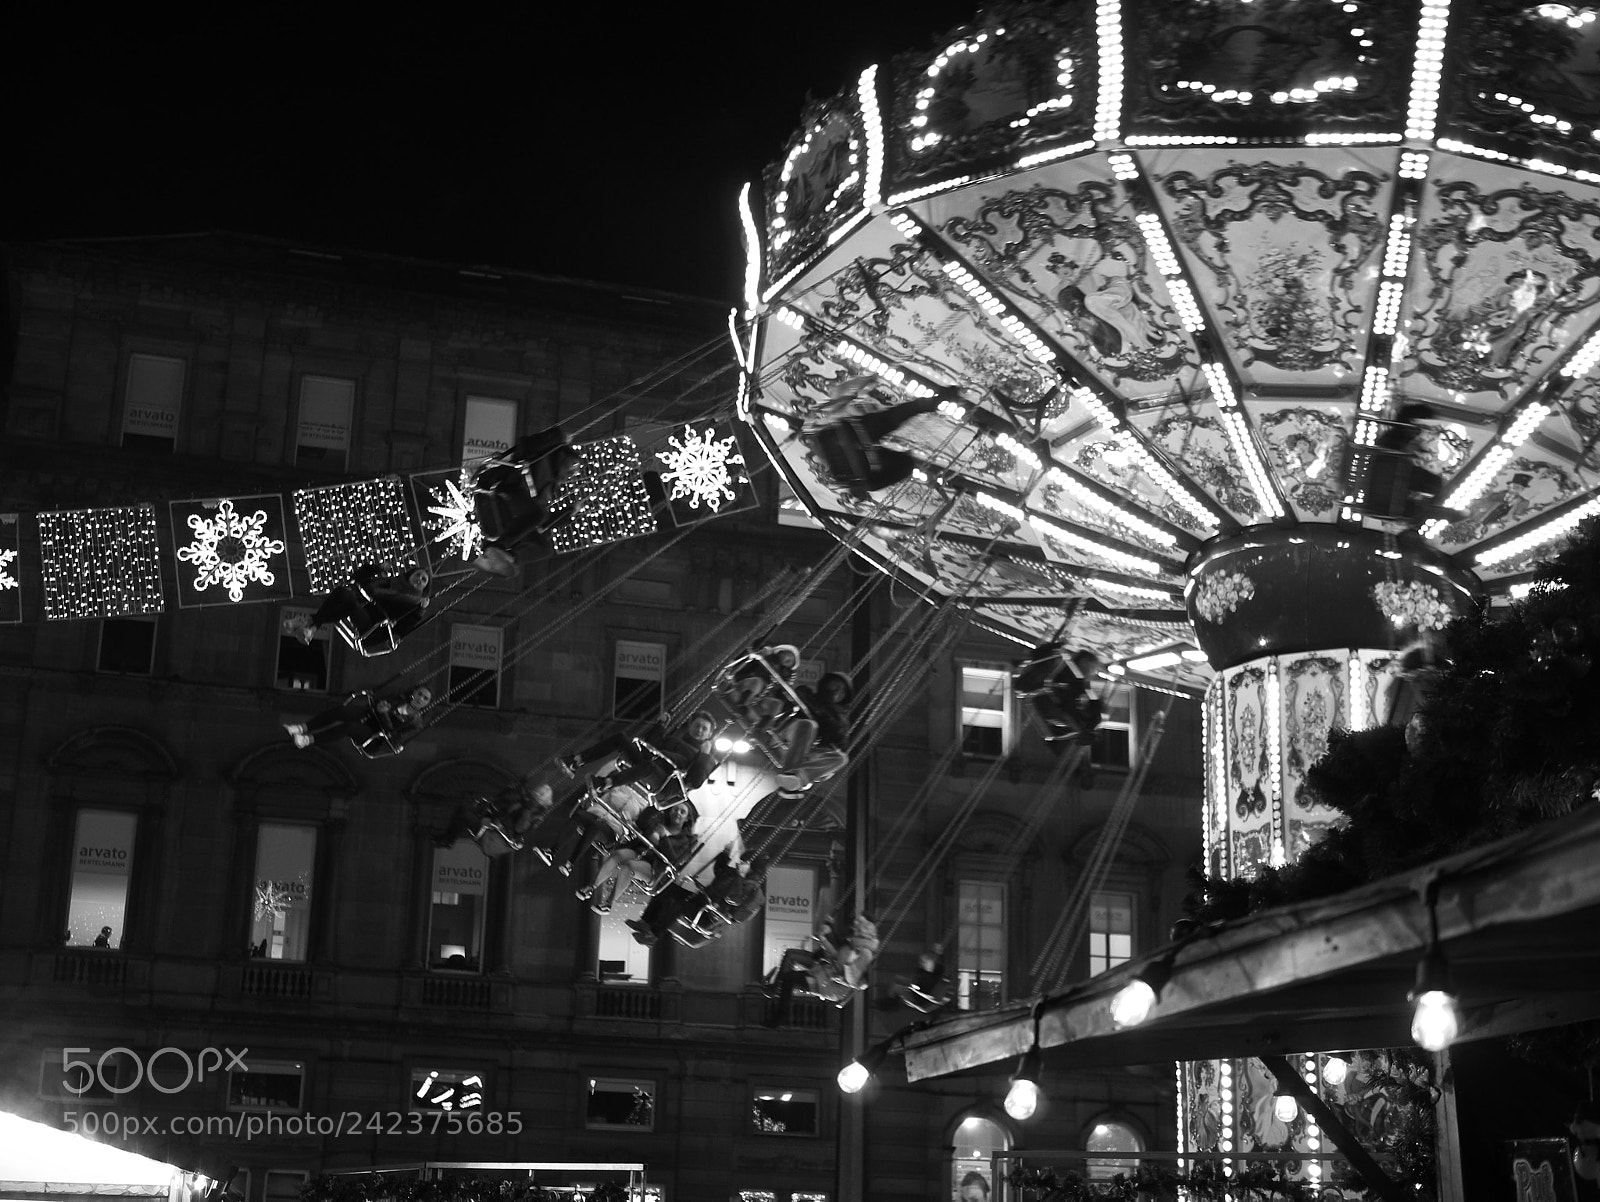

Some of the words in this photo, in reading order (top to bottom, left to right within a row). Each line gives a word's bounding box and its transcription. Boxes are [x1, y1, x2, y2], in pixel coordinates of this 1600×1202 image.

[129, 409, 175, 422] arvato
[467, 438, 509, 450] arvato
[454, 641, 497, 654] arvato
[618, 653, 660, 665] arvato
[80, 847, 127, 860] arvato
[79, 858, 126, 868] BERTELSMANN
[438, 866, 482, 879] arvato
[260, 881, 305, 894] avato
[438, 877, 481, 887] BERTELSMANN
[768, 895, 810, 907] arvato
